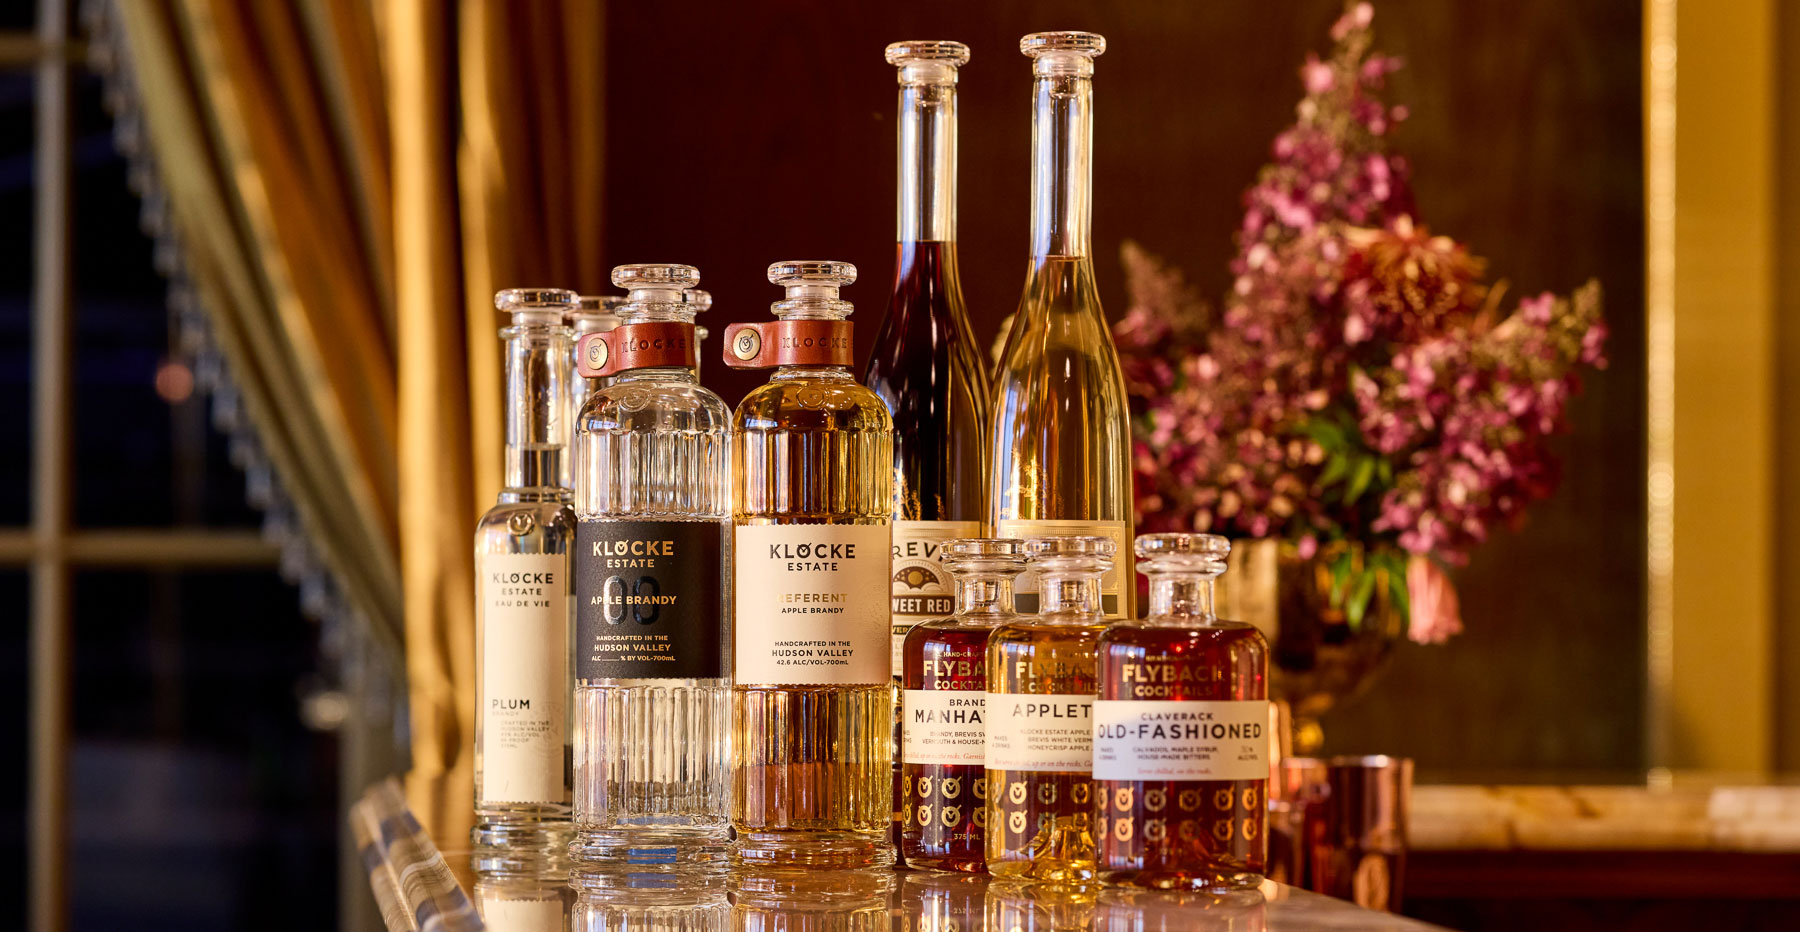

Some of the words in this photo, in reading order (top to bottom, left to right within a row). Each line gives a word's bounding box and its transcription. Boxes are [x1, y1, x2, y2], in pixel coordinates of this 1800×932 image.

[892, 541, 943, 561] REV
[607, 559, 655, 568] ESTATE
[788, 562, 838, 571] ESTATE
[502, 588, 542, 596] ESTATE
[591, 596, 623, 605] APPLE
[626, 596, 677, 604] BRANDY
[927, 599, 951, 613] RED
[1122, 664, 1225, 682] FLYBACK
[1135, 685, 1213, 697] COCKTAILS
[492, 699, 530, 710] PLUM
[915, 709, 986, 724] MANHA
[1141, 712, 1214, 721] CLAVERACK
[1098, 724, 1262, 740] OLD-FASHIONED
